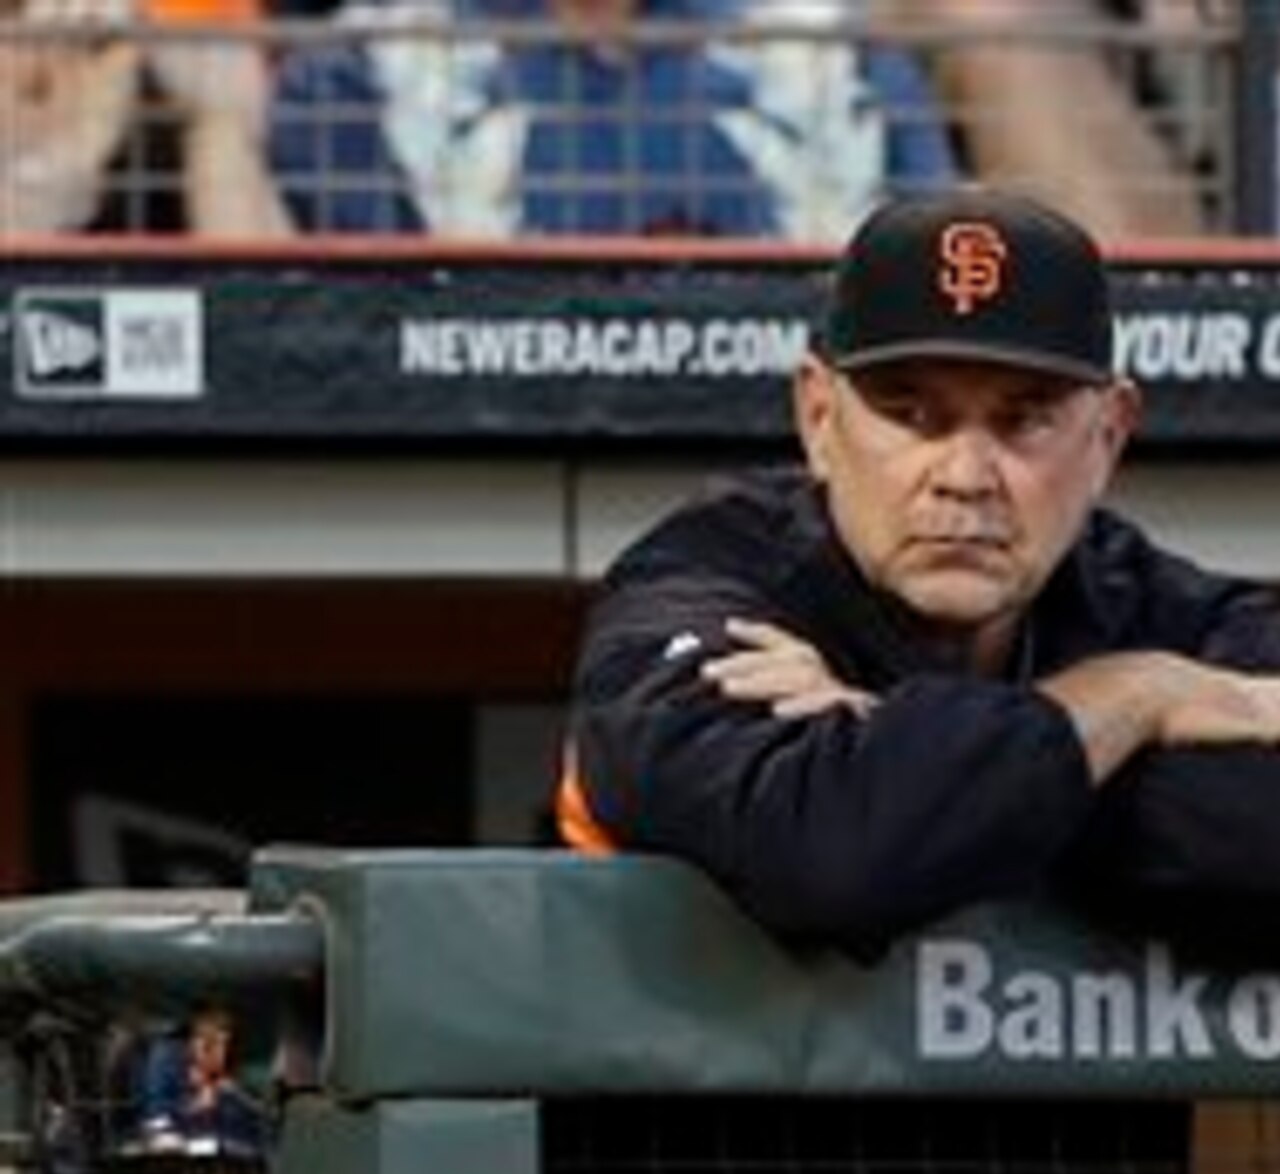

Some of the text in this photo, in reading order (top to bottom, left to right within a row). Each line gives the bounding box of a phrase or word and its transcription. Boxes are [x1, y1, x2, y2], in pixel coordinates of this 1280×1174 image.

[402, 320, 808, 374] NEWERACAP.COM
[1112, 312, 1252, 378] YOUR
[916, 940, 1210, 1060] Bank
